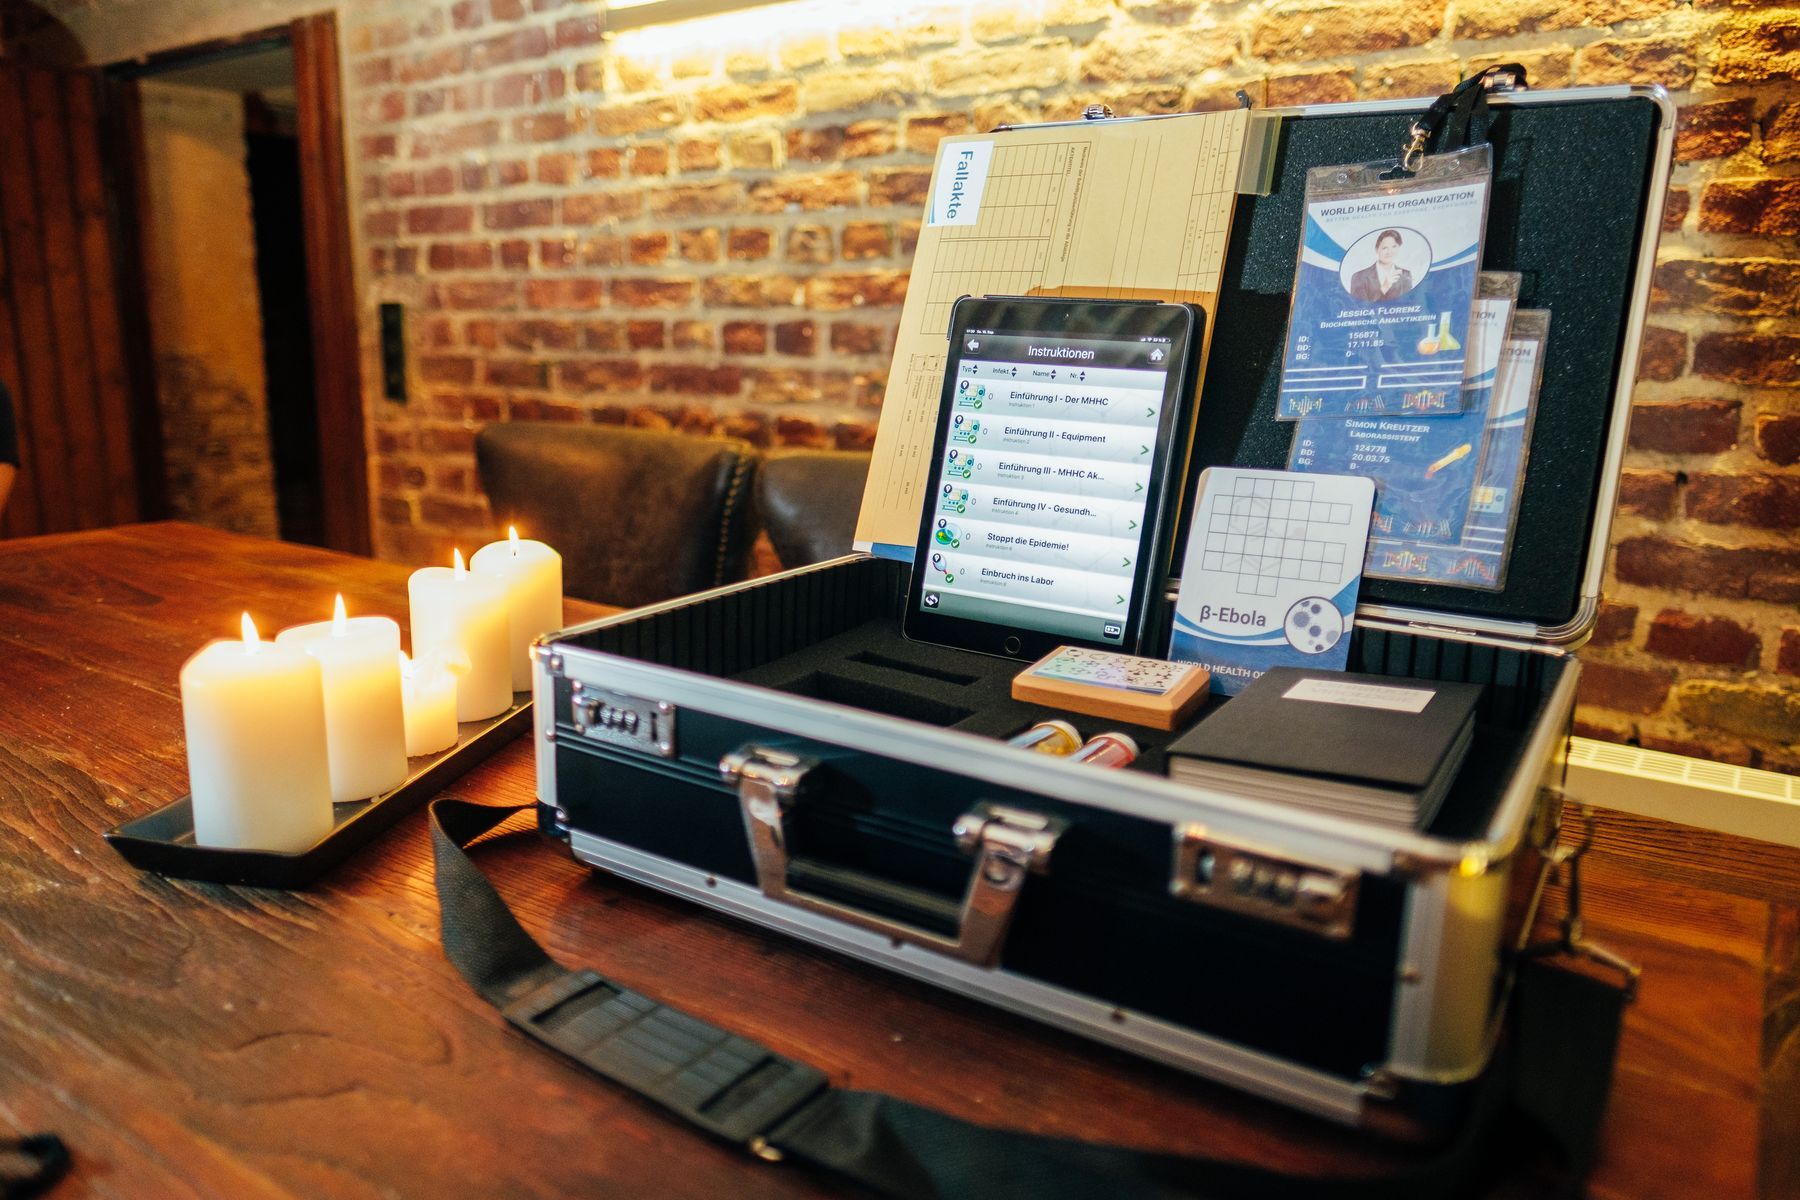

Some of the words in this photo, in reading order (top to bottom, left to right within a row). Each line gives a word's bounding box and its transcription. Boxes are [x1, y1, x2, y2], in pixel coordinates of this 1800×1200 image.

[947, 151, 973, 219] Fallakte
[1321, 207, 1355, 217] WORLD
[1357, 202, 1395, 213] HEALTH
[1398, 191, 1475, 208] ORGANIZATION
[1337, 309, 1375, 319] JESSICA
[1378, 305, 1421, 315] FLORENZ
[1320, 318, 1377, 329] BIOCHEMISCHE
[1379, 315, 1436, 324] ANALYTIKERIN
[1298, 335, 1309, 343] ID:
[1028, 345, 1095, 360] Instruktionen
[1010, 391, 1055, 404] Einführung
[1065, 395, 1079, 404] Der
[1081, 396, 1109, 406] MHHC
[1345, 419, 1377, 429] SIMON
[1379, 422, 1430, 433] KREUTZER
[1004, 427, 1048, 439] Einführung
[1061, 432, 1106, 443] Equipment
[1350, 430, 1420, 442] LABORASSISTENT
[1351, 453, 1391, 463] 20.03.75
[998, 462, 1042, 475] Einführung
[1058, 468, 1085, 479] MHHC
[993, 497, 1036, 511] Einführung
[987, 532, 1014, 544] Stoppt
[1015, 537, 1028, 545] die
[1028, 538, 1069, 551] Epidemie!
[981, 568, 1016, 580] Einbruch
[1017, 574, 1029, 582] ins
[1030, 575, 1054, 586] Labor
[1200, 605, 1266, 627] β-Ebola
[1212, 665, 1251, 678] HEALTH
